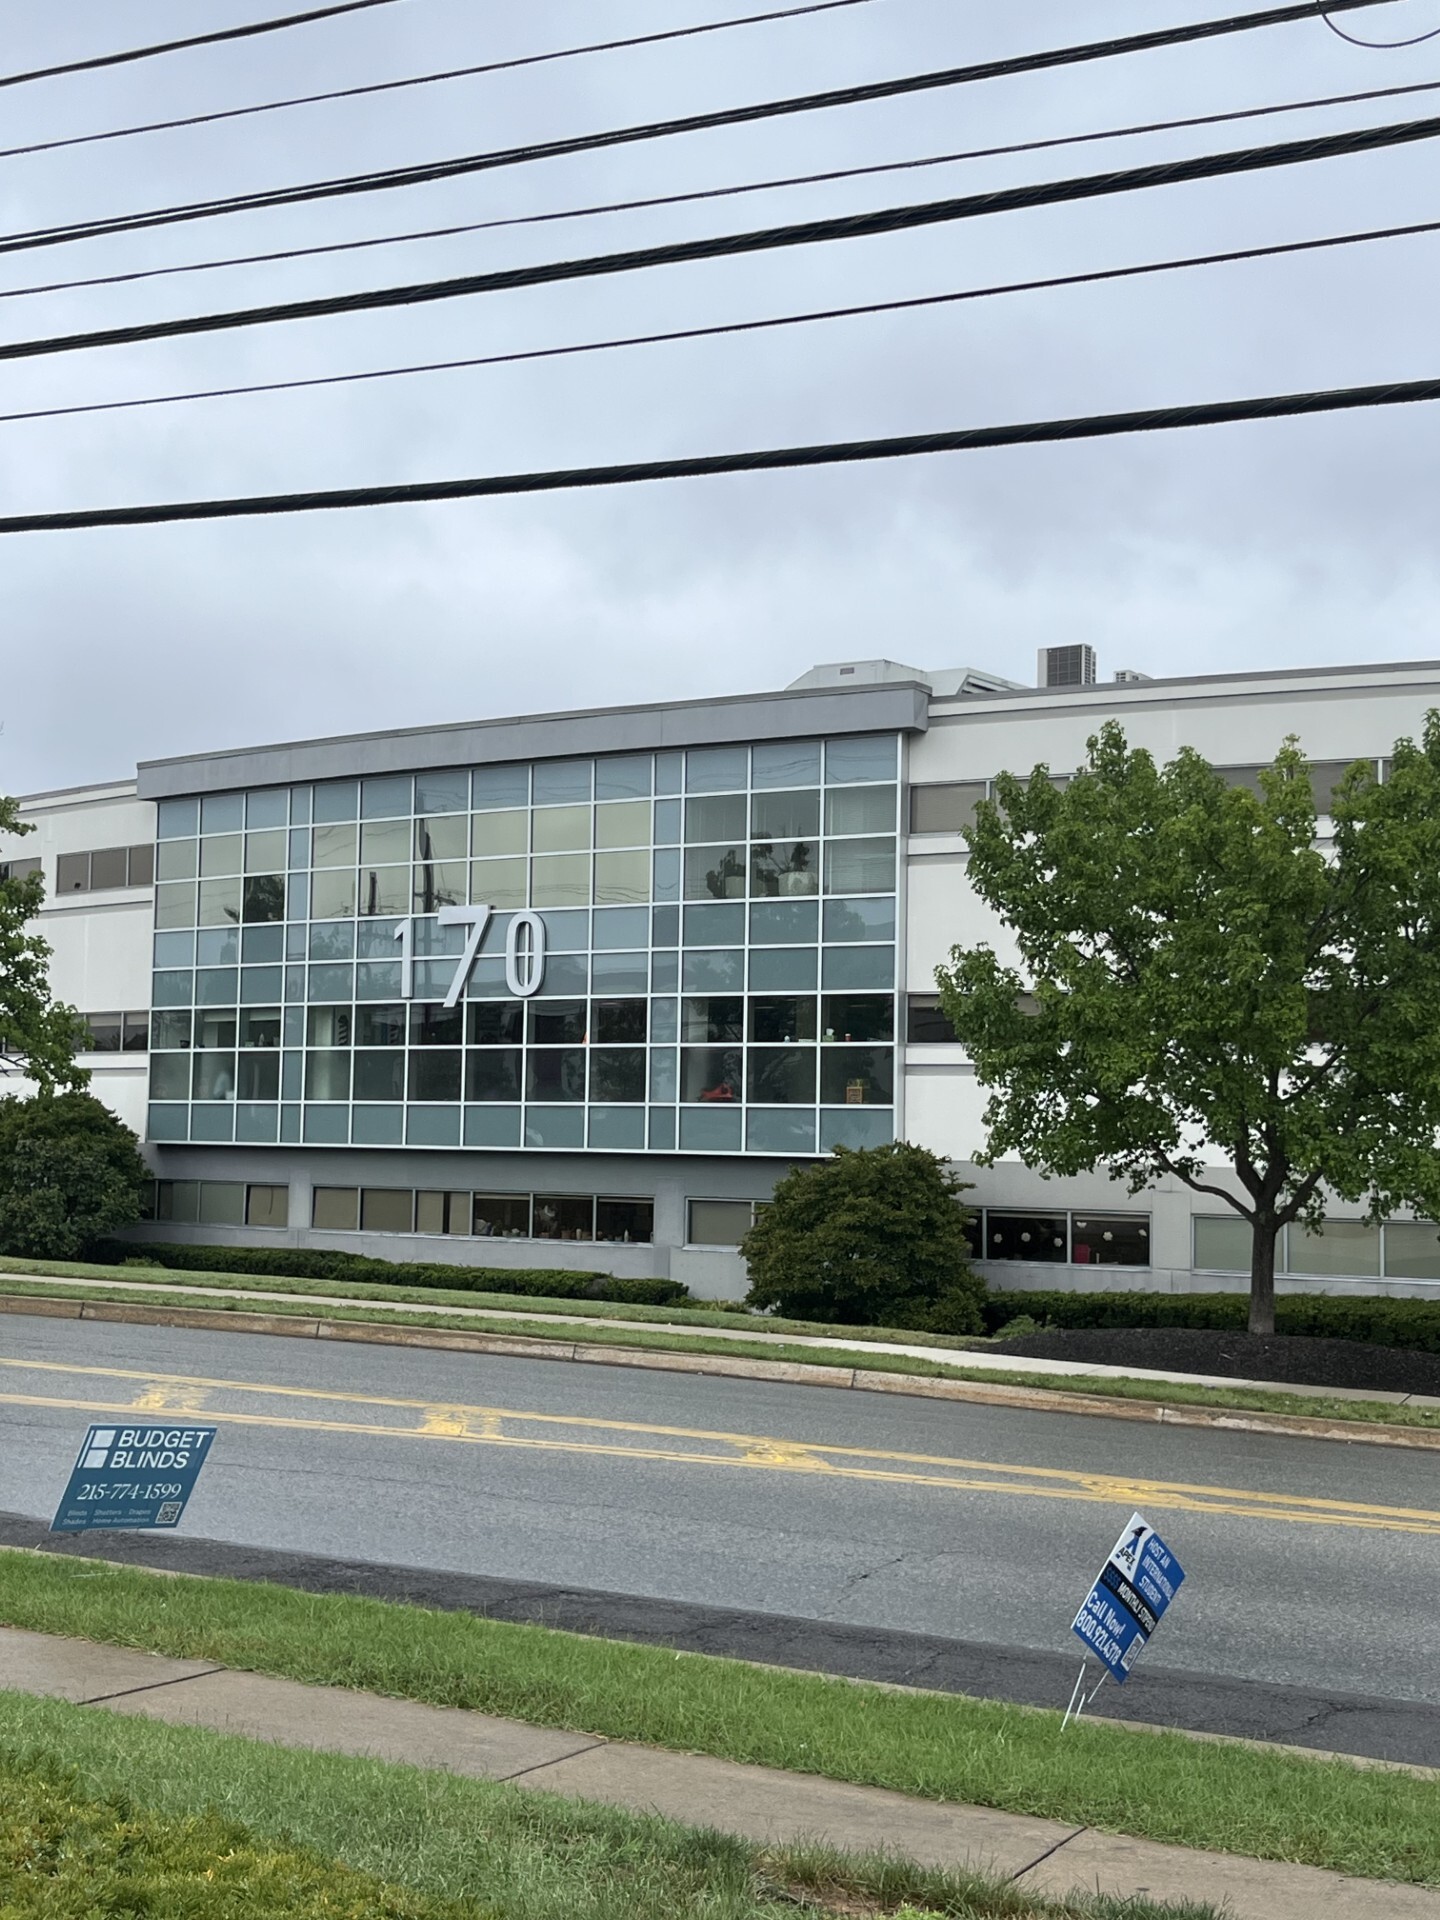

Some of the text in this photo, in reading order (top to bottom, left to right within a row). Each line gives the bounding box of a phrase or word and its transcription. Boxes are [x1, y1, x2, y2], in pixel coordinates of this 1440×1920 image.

[394, 904, 545, 1007] 170
[118, 1429, 210, 1448] BUDGET
[110, 1451, 190, 1469] BLINDS
[77, 1483, 182, 1500] 215-774-1599
[93, 1508, 122, 1517] Shutters
[1118, 1547, 1136, 1565] APEX
[1147, 1537, 1171, 1569] HOST AN
[1141, 1554, 1175, 1602] INTERNATIONAL
[1086, 1591, 1126, 1639] Call Now!
[1117, 1581, 1144, 1614] MONTHLY
[1138, 1606, 1156, 1632] STIPEND
